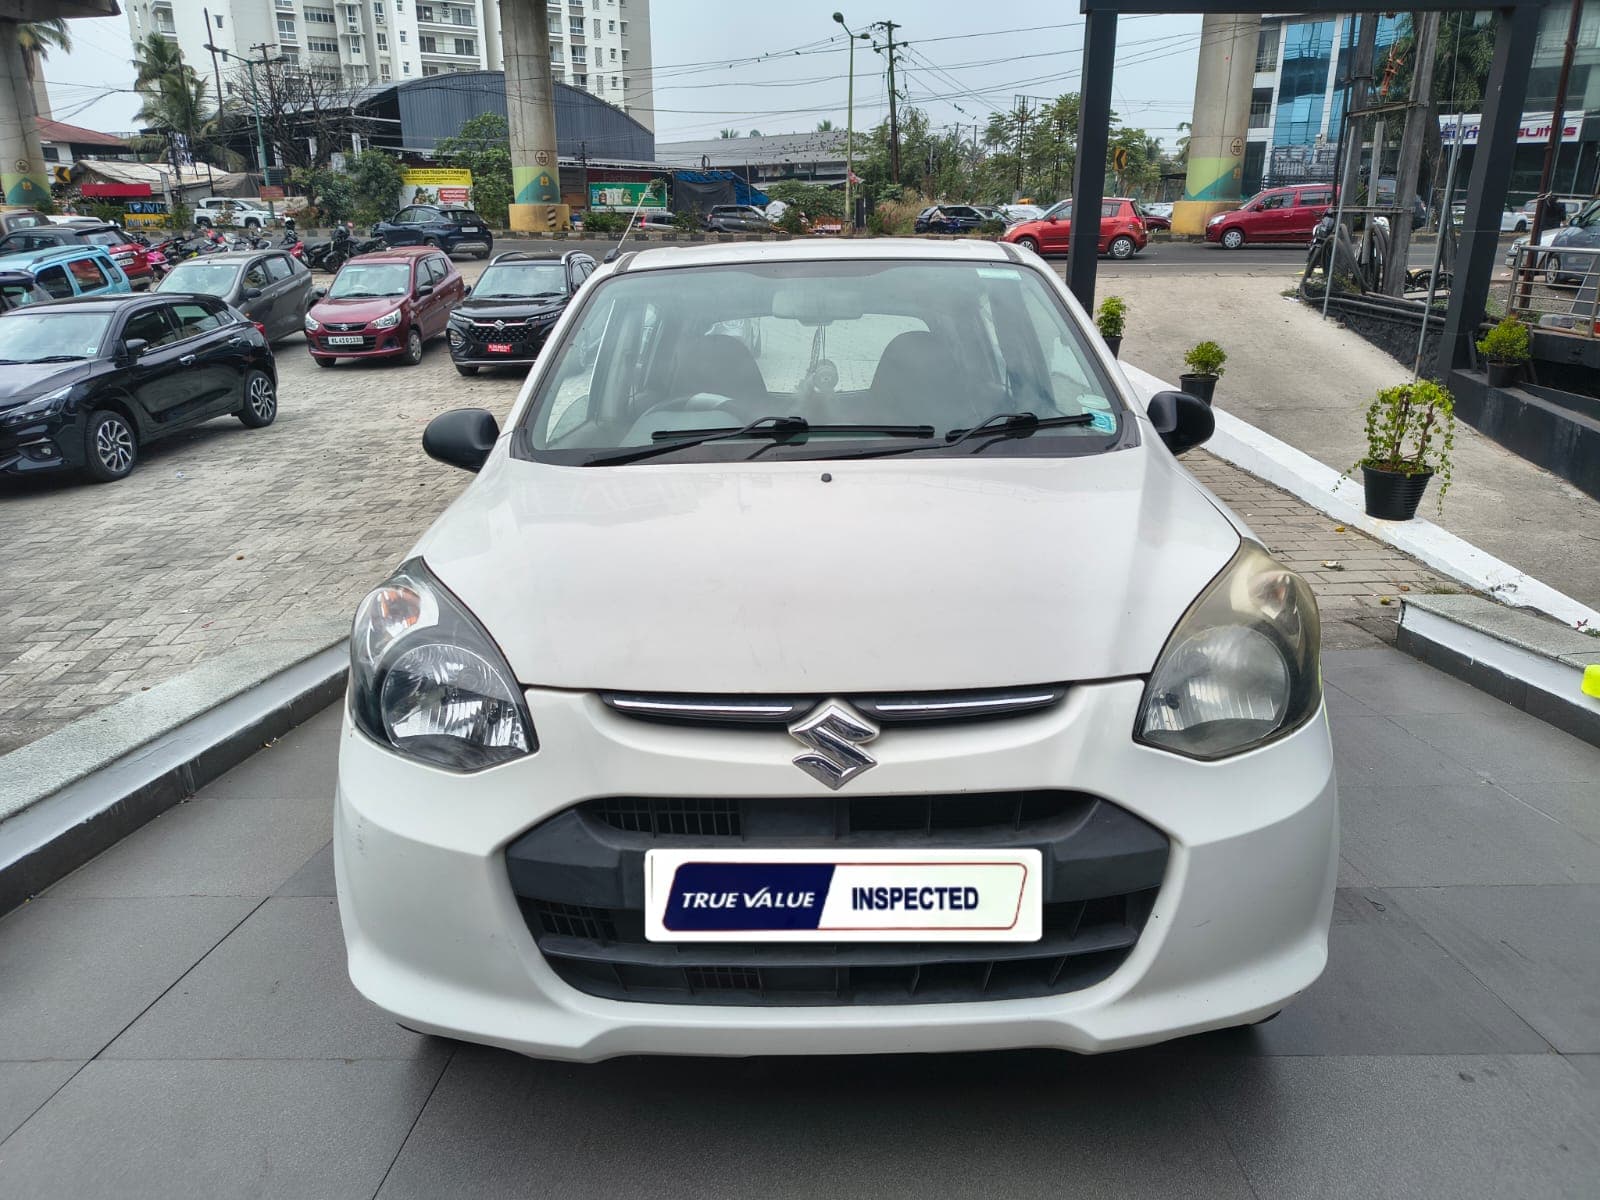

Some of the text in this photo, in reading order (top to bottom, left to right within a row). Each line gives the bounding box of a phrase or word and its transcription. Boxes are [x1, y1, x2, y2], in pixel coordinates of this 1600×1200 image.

[681, 886, 979, 911] TRUE VALUE INSPECTED
